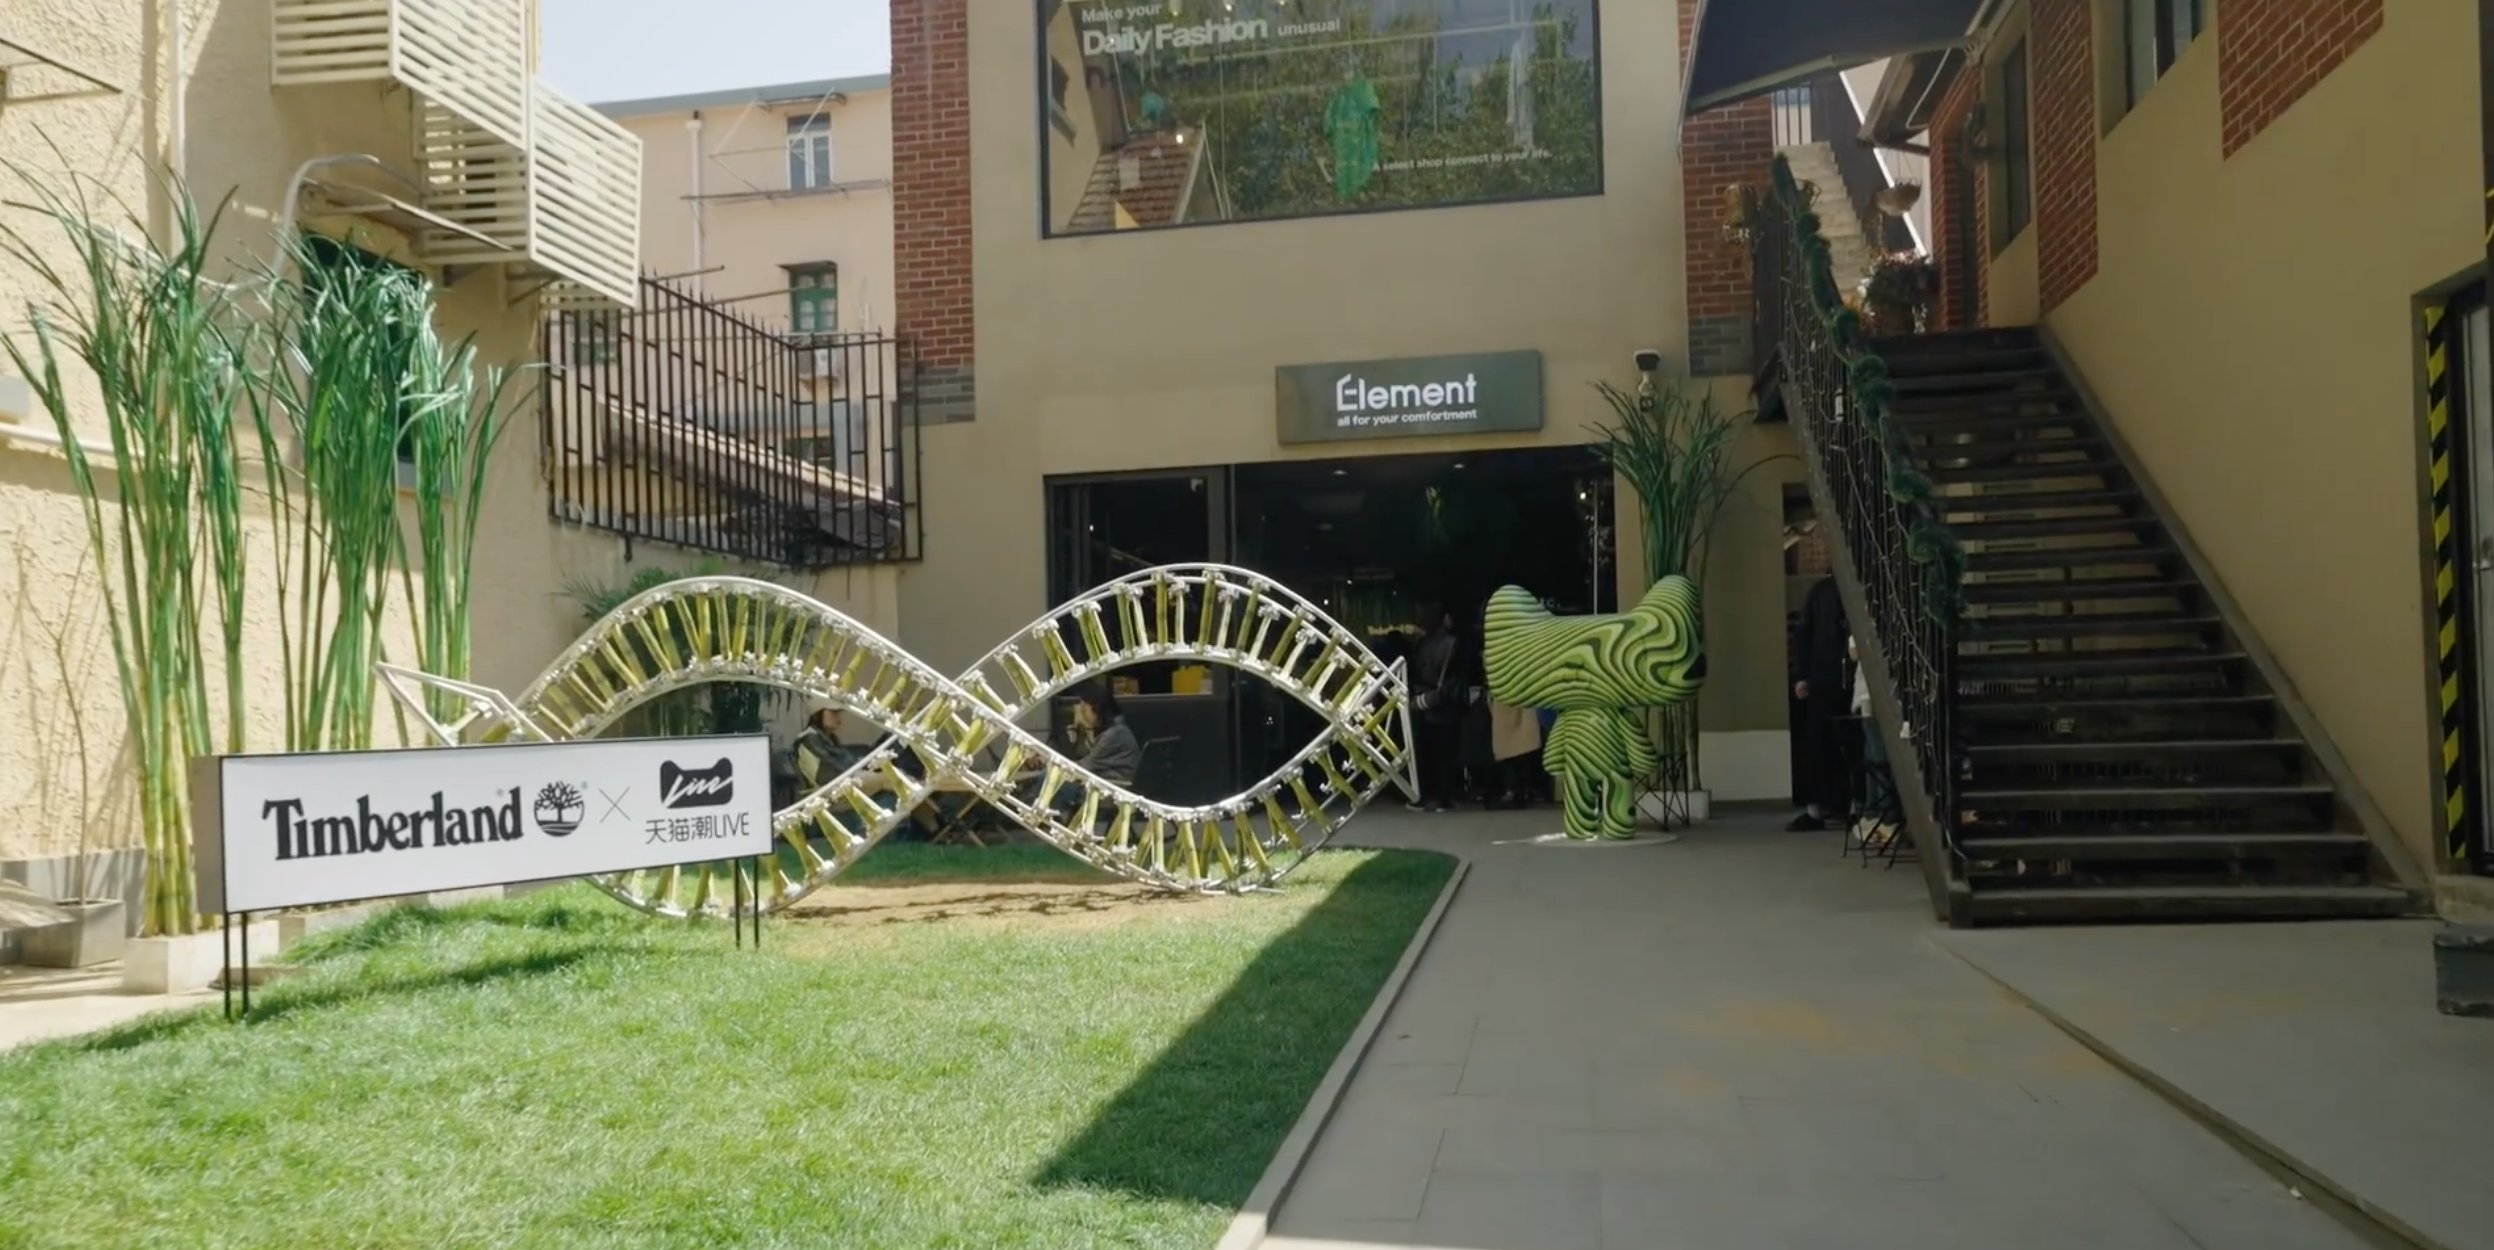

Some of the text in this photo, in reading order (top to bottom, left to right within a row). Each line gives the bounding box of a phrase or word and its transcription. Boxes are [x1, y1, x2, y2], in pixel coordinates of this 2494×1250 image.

[1081, 3, 1162, 23] Make your
[1083, 17, 1340, 56] Daily Fashion unusual
[1383, 159, 1415, 171] select
[1416, 157, 1443, 169] shop
[1445, 154, 1489, 166] connect
[1491, 153, 1503, 163] to
[1504, 150, 1530, 162] your
[1336, 373, 1477, 411] Element
[1337, 409, 1478, 427] all for your comfortment
[262, 786, 525, 861] Timberland
[645, 812, 750, 845] 天猫潮LIVE
